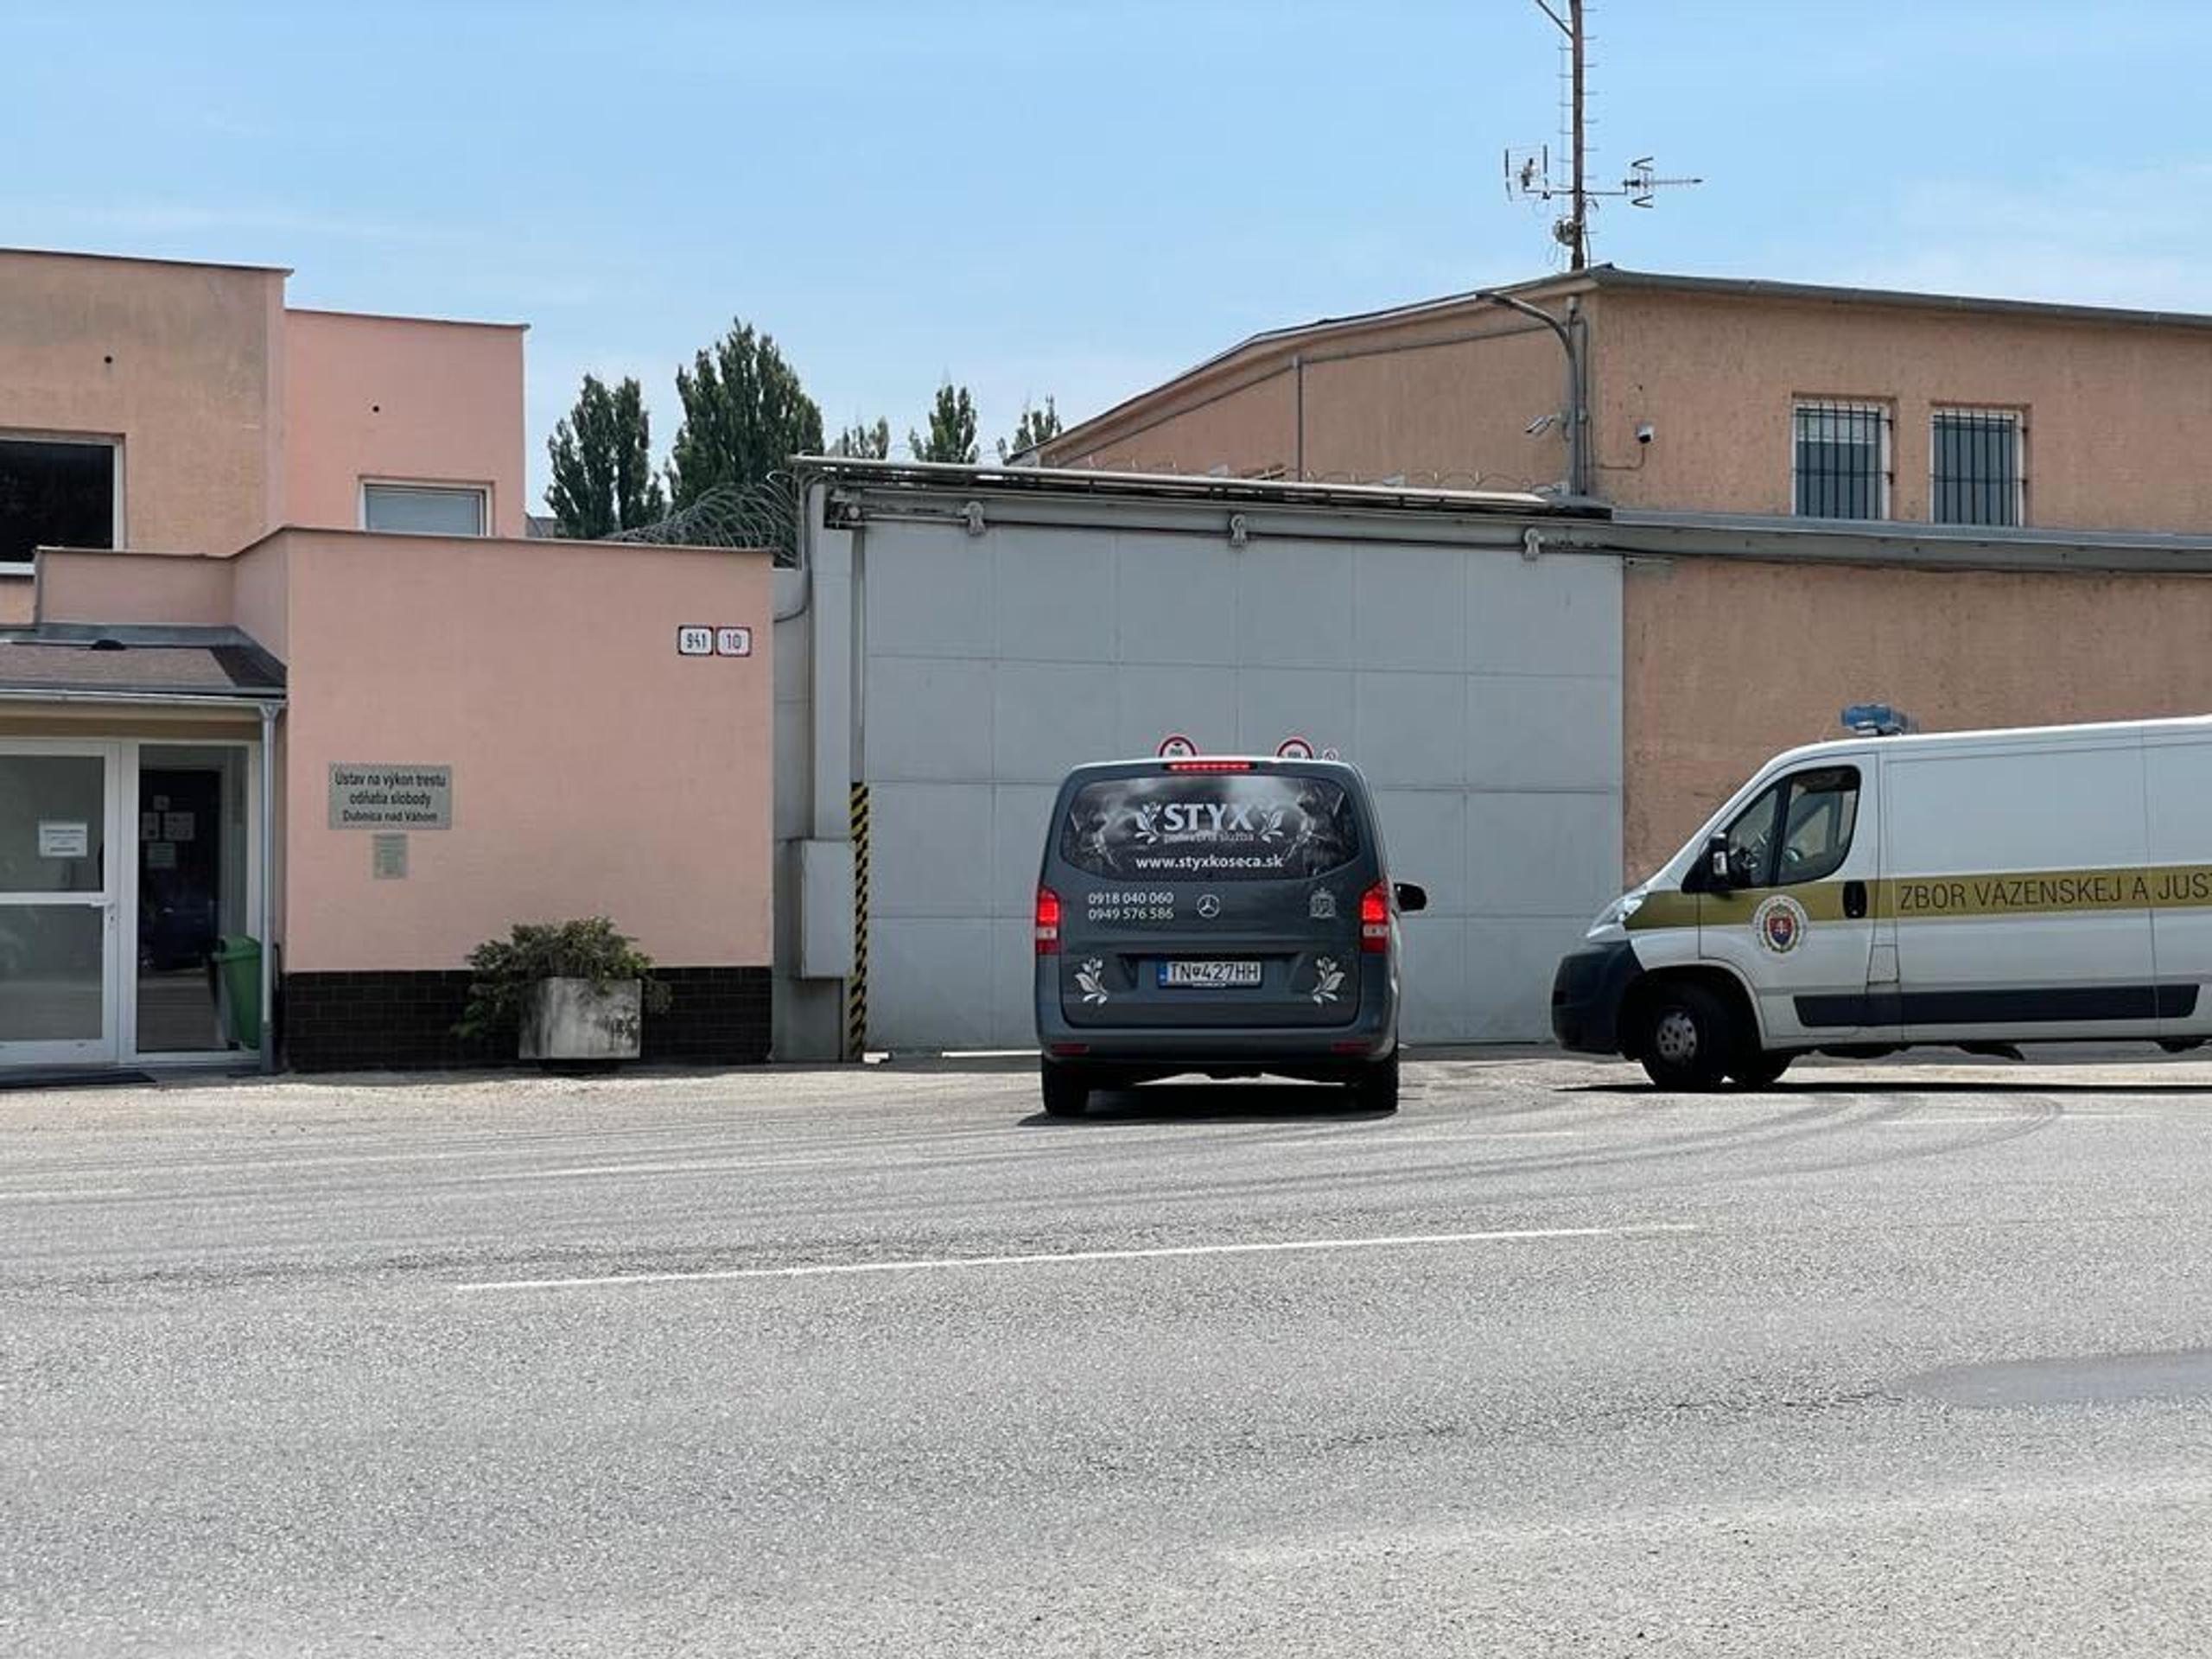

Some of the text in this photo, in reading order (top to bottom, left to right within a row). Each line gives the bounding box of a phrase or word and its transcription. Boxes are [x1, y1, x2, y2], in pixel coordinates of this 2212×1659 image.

[686, 632, 742, 650] 941 10
[367, 775, 381, 786] na
[391, 790, 432, 810] slobody
[342, 810, 382, 822] Dubnica
[385, 810, 403, 822] nad
[1164, 804, 1255, 831] STYX
[1135, 854, 1284, 872] www.styxkoseca.sk
[1089, 892, 1174, 905] 0918 040 060
[1900, 882, 1967, 910] ZBOR
[2132, 876, 2149, 900] A
[1089, 908, 1174, 920] 0949 576 586
